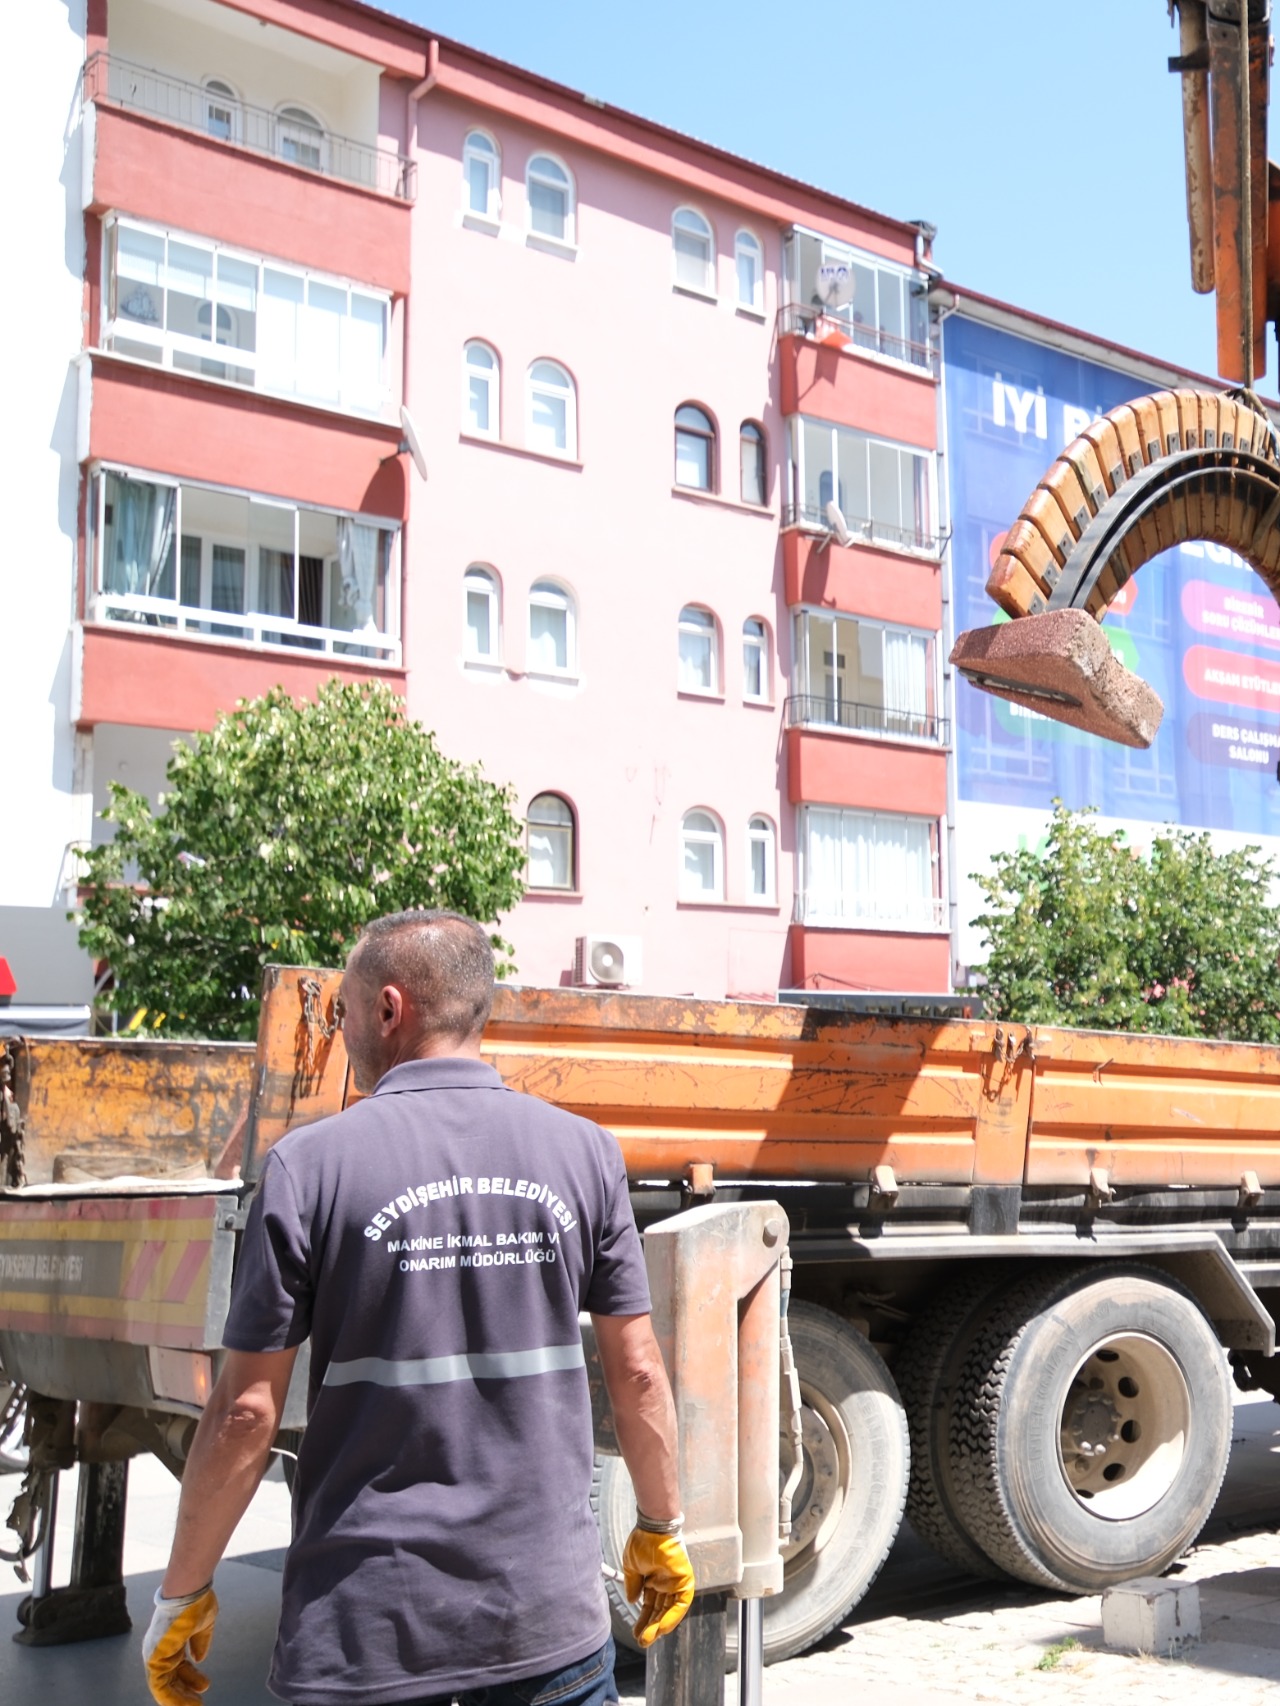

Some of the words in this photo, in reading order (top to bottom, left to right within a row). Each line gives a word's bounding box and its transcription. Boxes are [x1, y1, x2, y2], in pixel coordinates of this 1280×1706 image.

[992, 372, 1047, 440] İYİ
[1204, 668, 1240, 687] AKŞAM
[1211, 722, 1240, 741] DERS
[1229, 745, 1269, 764] SALONU
[364, 1175, 474, 1242] SEYDİŞEHİR
[477, 1177, 578, 1233] BELEDİYESİ
[387, 1236, 443, 1253] MAKİNE
[447, 1233, 492, 1248] İKMAL
[496, 1231, 543, 1246] BAKIM
[400, 1255, 456, 1272] ONARIM
[460, 1248, 556, 1268] MÜDÜRLÜĞÜ
